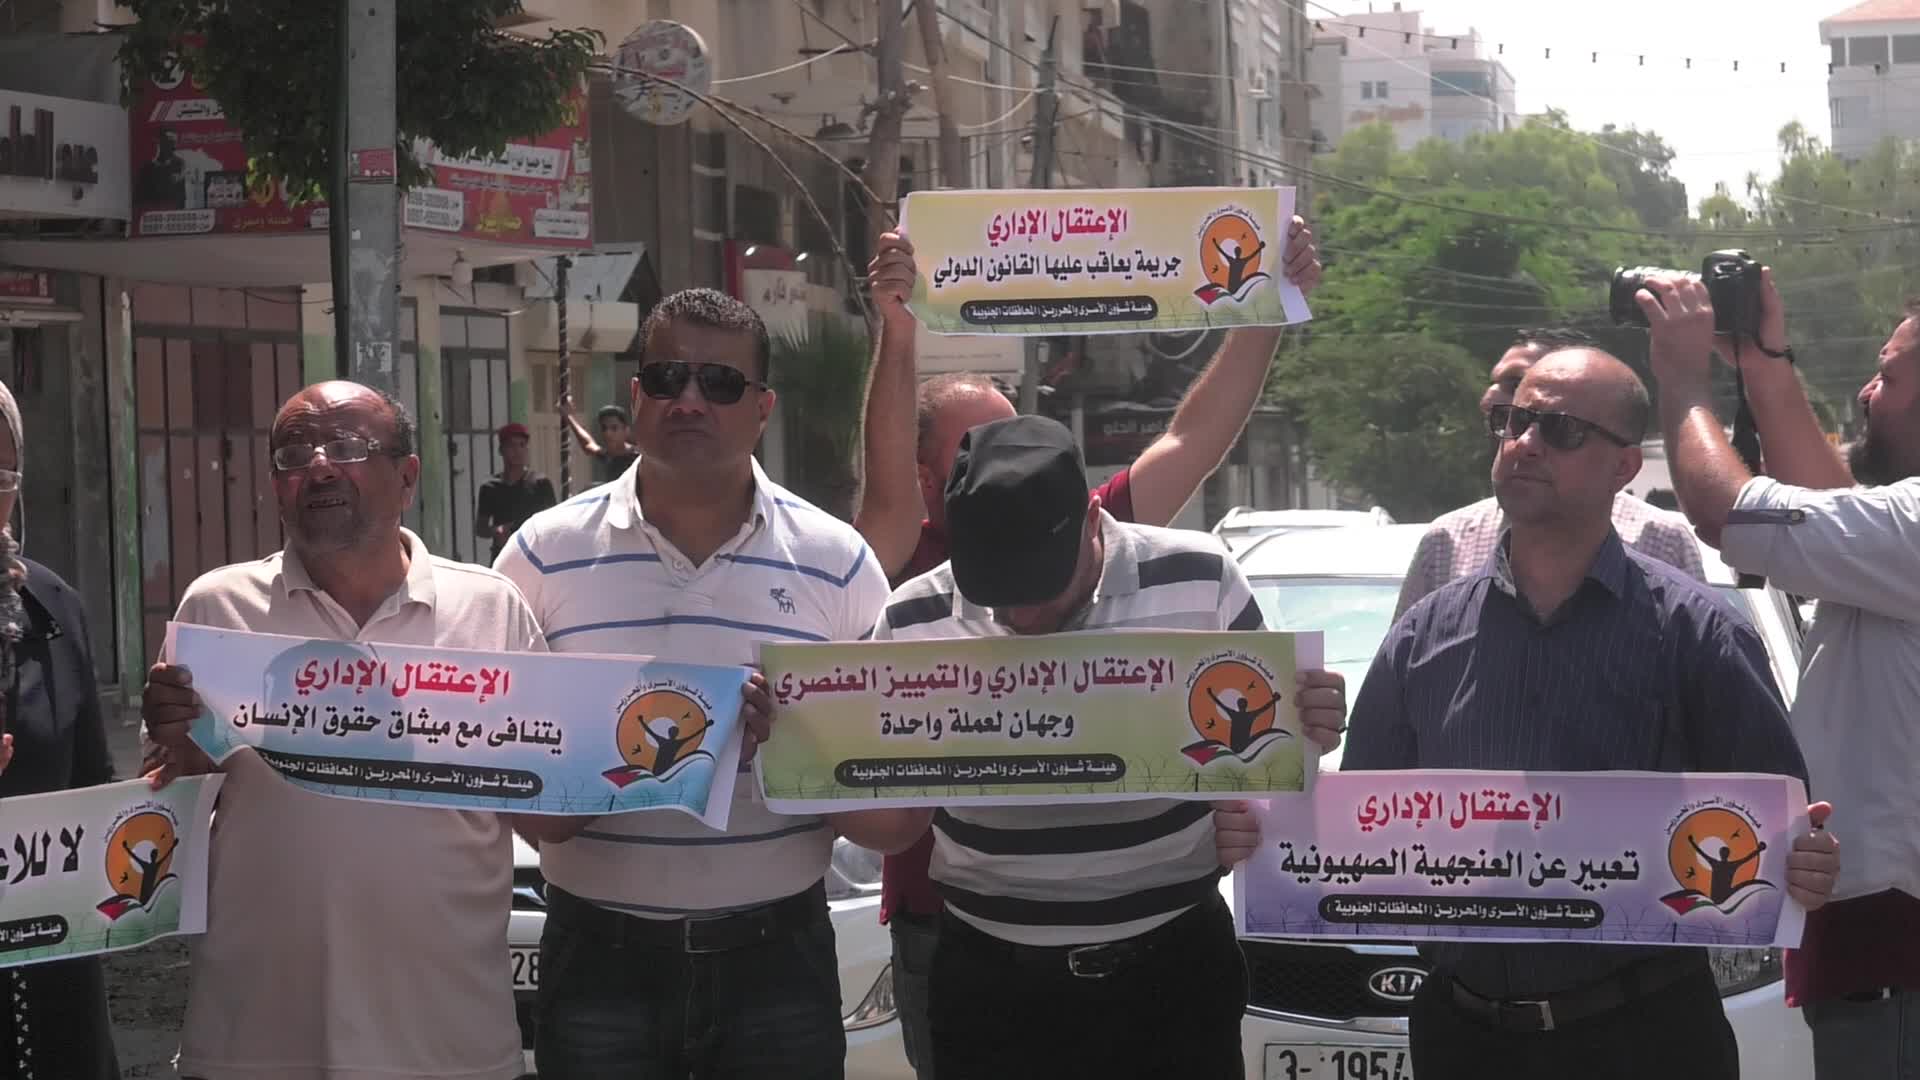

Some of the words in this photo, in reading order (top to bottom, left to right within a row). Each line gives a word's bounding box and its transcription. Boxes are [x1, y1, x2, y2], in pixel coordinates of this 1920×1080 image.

[987, 209, 1047, 247] الإداري
[1051, 207, 1127, 242] الإعتقال
[934, 255, 984, 289] الدولي
[986, 253, 1040, 282] القانون
[1045, 253, 1082, 282] عليها
[1087, 250, 1132, 280] يعاقب
[1136, 250, 1182, 279] جريمة
[295, 656, 386, 696] الإداري
[391, 662, 510, 704] الإعتقال
[774, 665, 877, 705] العنصري
[881, 663, 983, 698] والتمييز
[988, 658, 1066, 700] الإداري
[1073, 655, 1174, 694] الإعتقال
[233, 701, 317, 735] الإنسان
[323, 705, 381, 736] حقوق
[388, 706, 451, 744] ميثاق
[455, 722, 482, 748] مع
[880, 710, 943, 741] واحدة
[950, 708, 1003, 734] لعملة
[1009, 708, 1075, 739] وجهان
[487, 716, 563, 755] يتنافى
[466, 772, 499, 790] شؤون
[501, 774, 534, 792] هيئة
[1051, 759, 1085, 776] شؤون
[1086, 760, 1117, 774] هيئة
[1357, 790, 1443, 833] الإداري
[1450, 789, 1561, 831] الإعتقال
[60, 824, 84, 873] لا
[1279, 841, 1407, 884] الصهيونية
[1412, 843, 1522, 887] العنجهية
[1528, 851, 1567, 888] عن
[1570, 850, 1640, 892] تعبير
[1530, 904, 1564, 920] شؤون
[1566, 906, 1596, 920] هيئة
